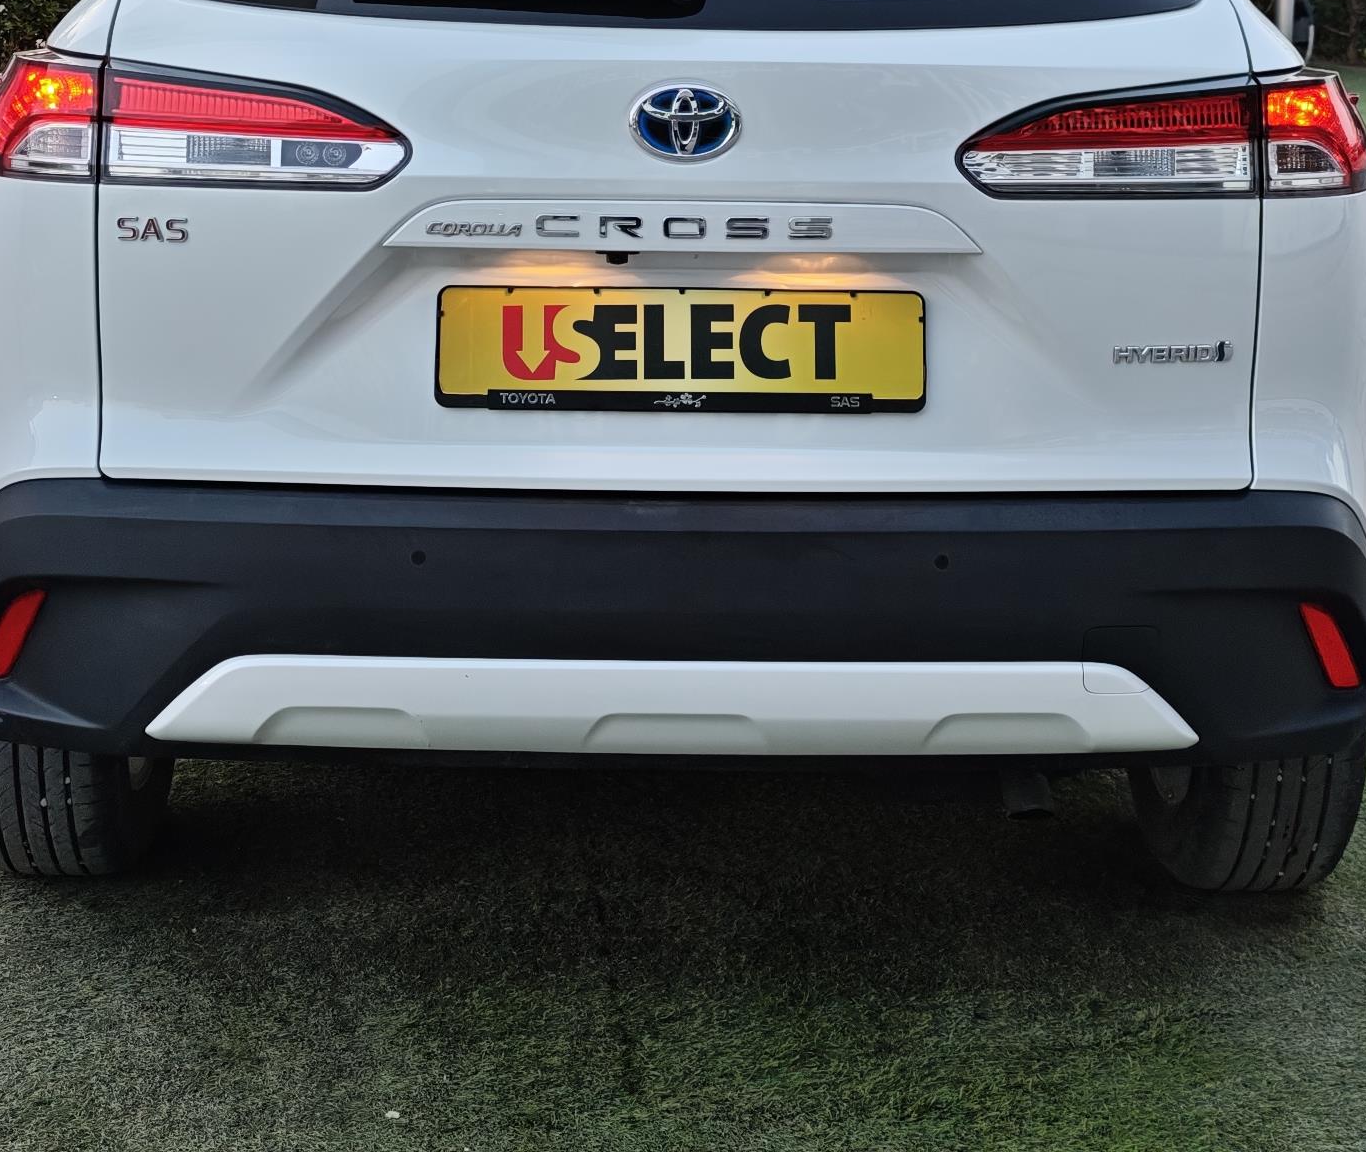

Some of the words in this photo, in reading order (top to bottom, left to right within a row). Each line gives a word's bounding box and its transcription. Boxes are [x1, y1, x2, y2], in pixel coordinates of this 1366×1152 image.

[116, 216, 190, 244] SAS
[425, 222, 523, 238] COROLLA
[535, 214, 834, 242] CROSS
[501, 303, 852, 381] USELECT
[1113, 344, 1215, 365] HYBRID
[499, 392, 556, 406] TOYOTA
[830, 396, 860, 409] SAS
